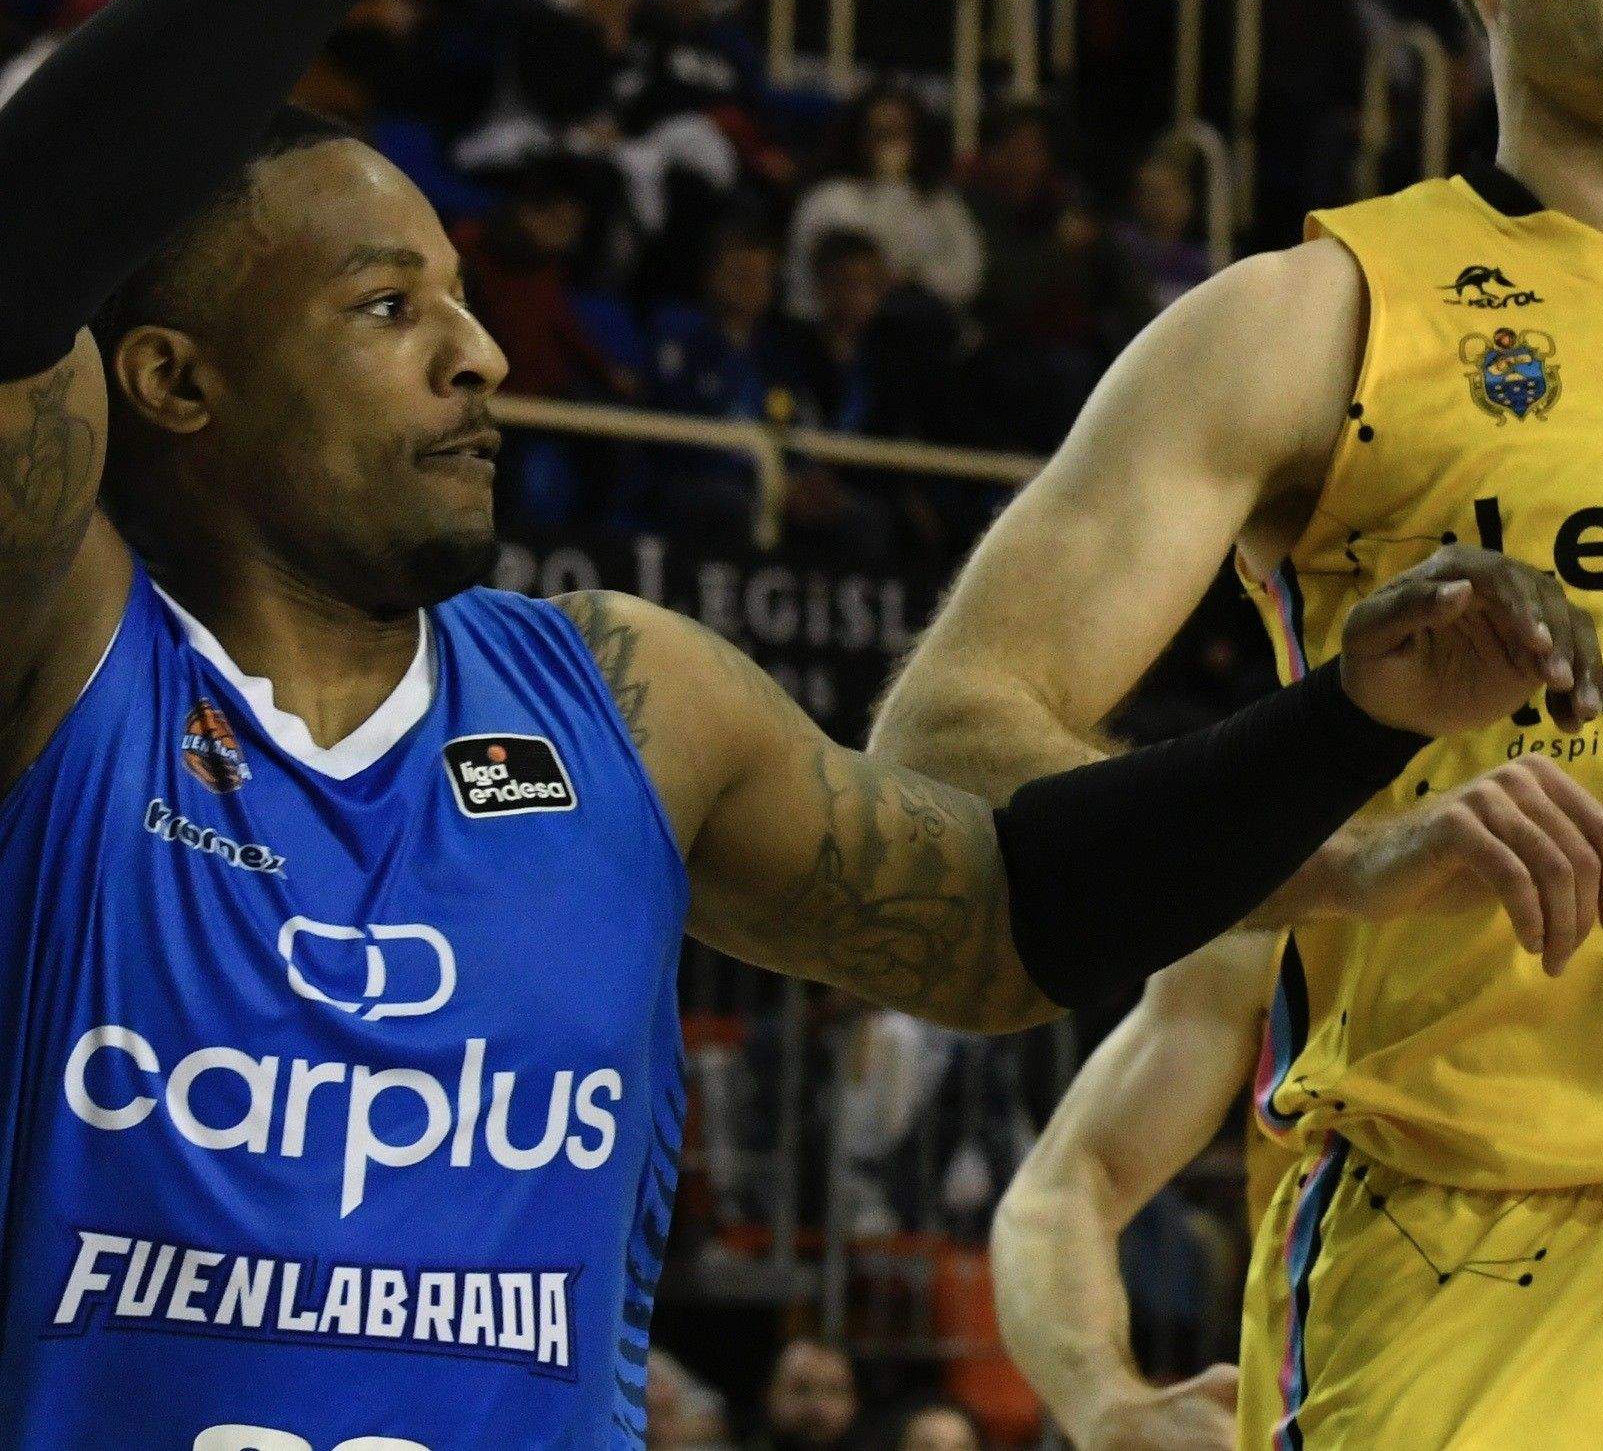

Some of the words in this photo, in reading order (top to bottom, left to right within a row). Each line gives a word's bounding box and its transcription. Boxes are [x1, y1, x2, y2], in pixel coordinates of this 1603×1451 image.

[459, 760, 510, 787] liga
[468, 779, 567, 805] endesa
[63, 1024, 622, 1220] carplus
[53, 1230, 570, 1368] FUENLABRADA
